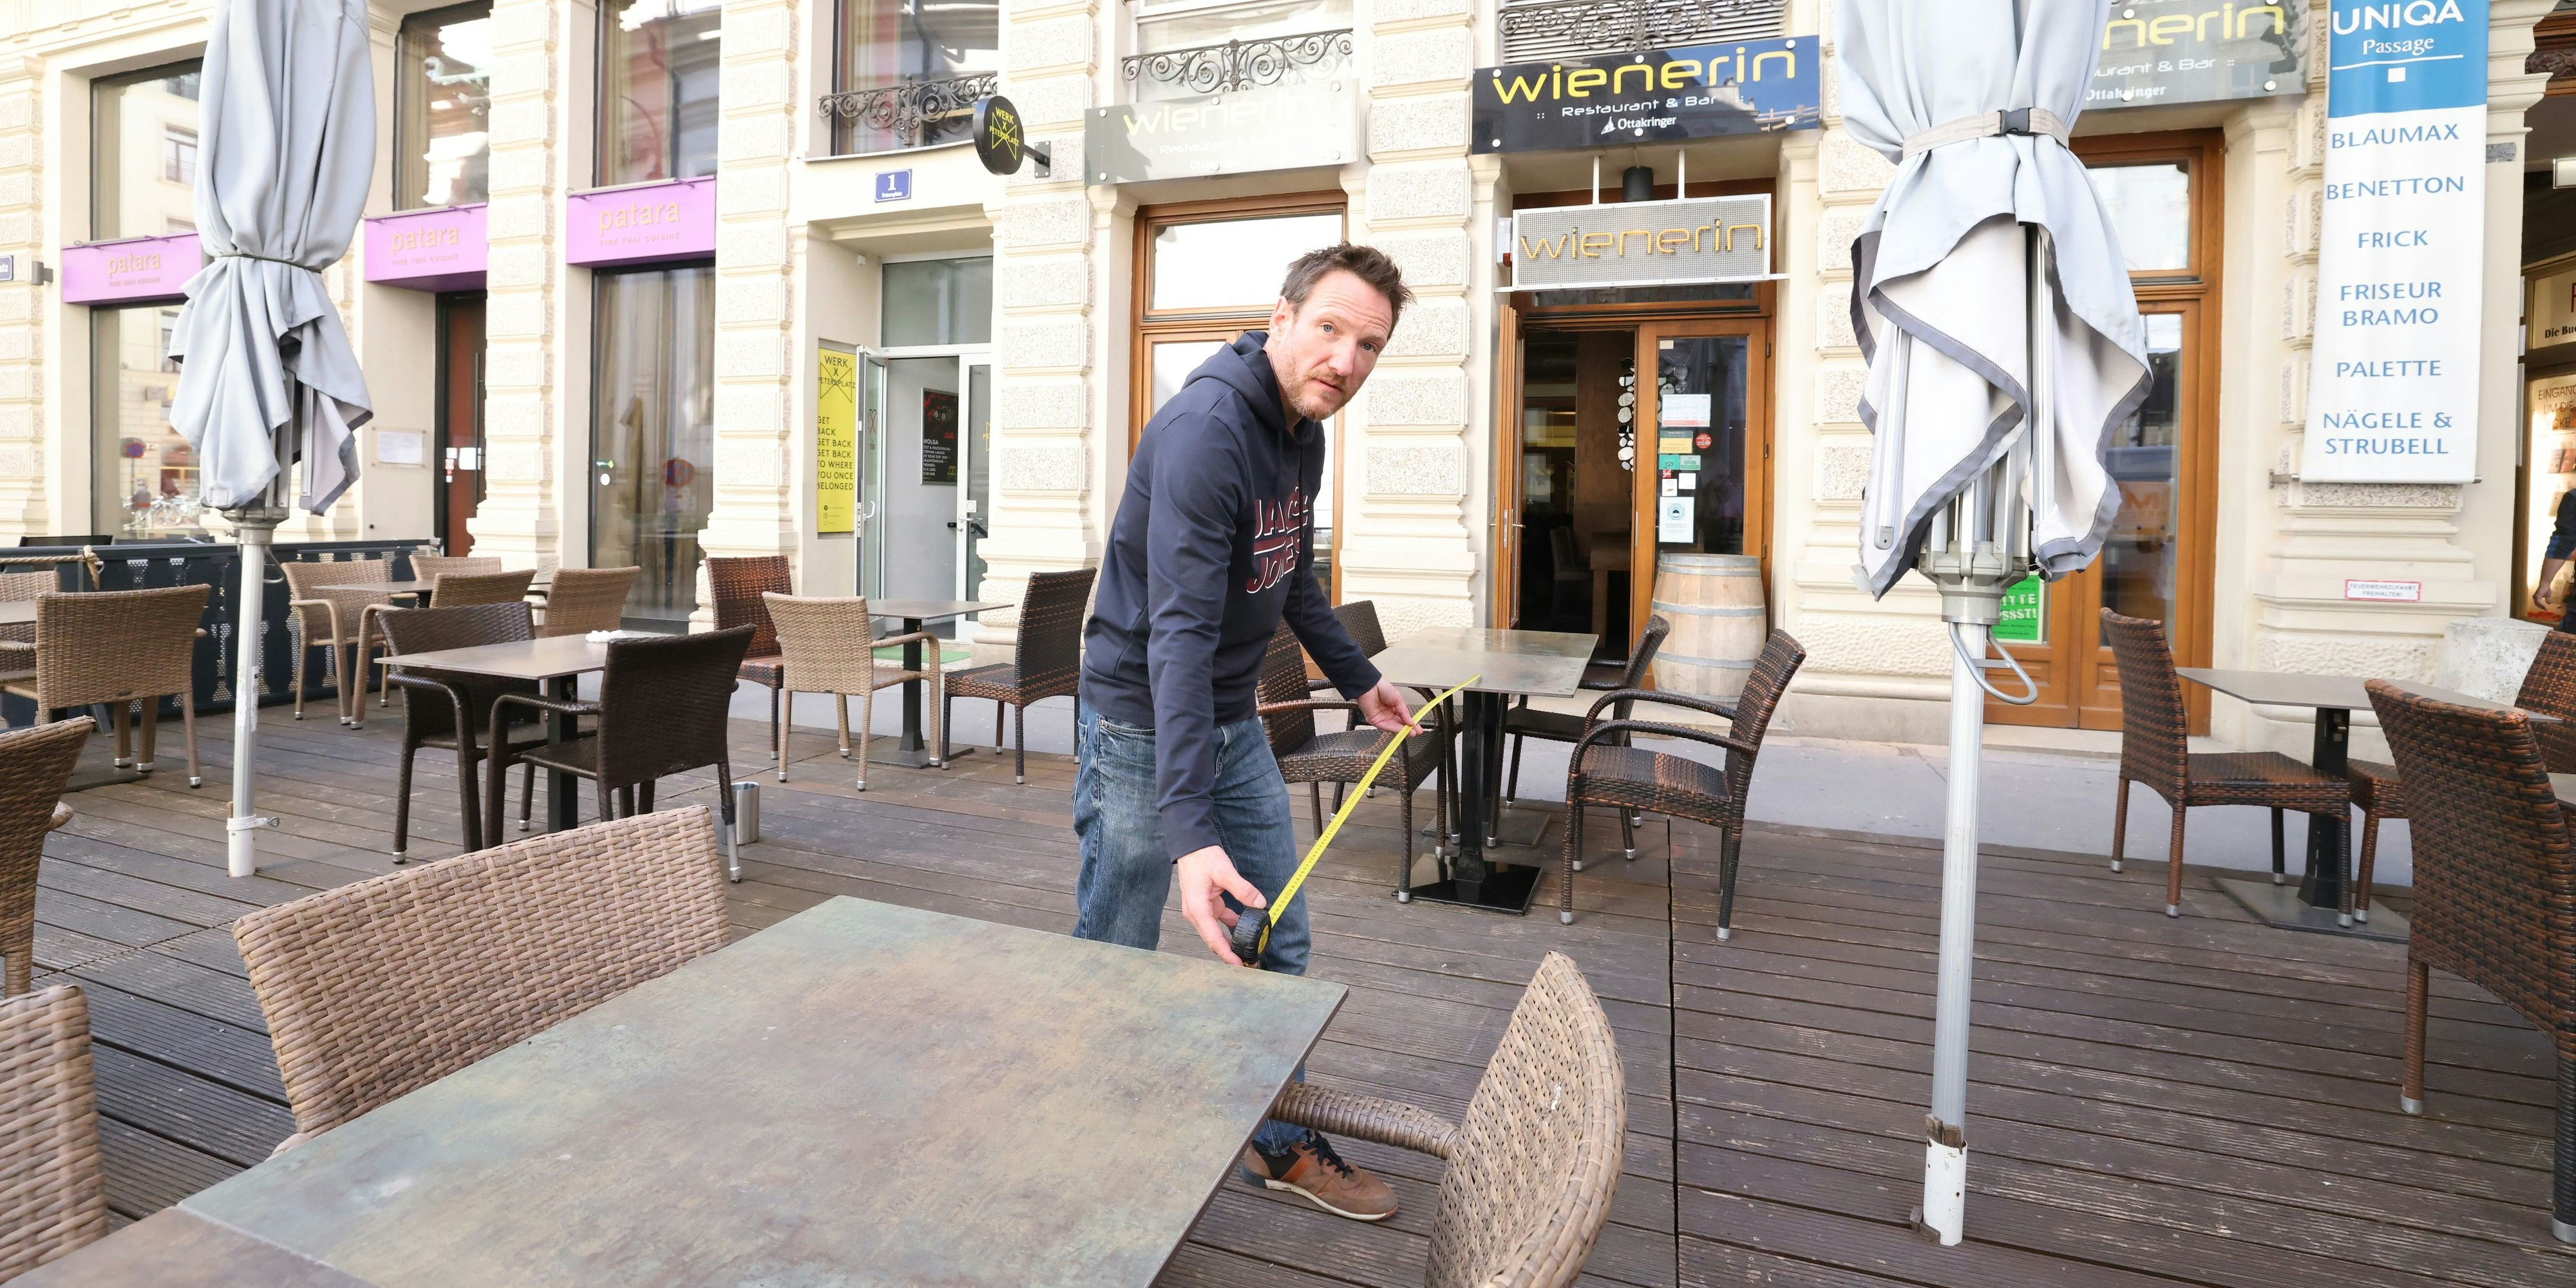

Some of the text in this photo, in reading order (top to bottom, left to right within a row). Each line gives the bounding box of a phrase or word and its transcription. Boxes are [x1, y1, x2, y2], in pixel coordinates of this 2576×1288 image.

[2331, 0, 2465, 35] UNIQA
[2363, 37, 2434, 56] Passage
[1492, 47, 1796, 104] wienerin
[2094, 59, 2217, 77] urant & Bar
[995, 106, 1014, 125] WERK
[1562, 96, 1716, 117] Restaurant & Bar
[1002, 120, 1007, 131] X
[1617, 117, 1677, 129] Ottakringer
[2331, 124, 2459, 149] BLAUMAX
[887, 173, 896, 191] 1
[2327, 176, 2464, 200] BENETTON
[599, 202, 681, 236] patara
[392, 226, 459, 258] patara
[1520, 219, 1763, 259] wienerin
[2358, 230, 2429, 249] FRICK
[108, 252, 161, 278] patara
[2340, 281, 2442, 301] FRISEUR
[2343, 308, 2439, 327] BRAMO
[2545, 328, 2559, 338] Die
[824, 355, 848, 368] WERK
[2336, 360, 2442, 378] PALETTE
[833, 367, 839, 377] X
[2543, 401, 2574, 414] UM DIE
[817, 416, 829, 424] GET
[2323, 409, 2452, 429] NÄGELE &
[817, 438, 851, 448] GET BACK
[2325, 438, 2449, 455] STRUBELL
[828, 460, 853, 469] WHERE
[834, 471, 853, 480] ONCE
